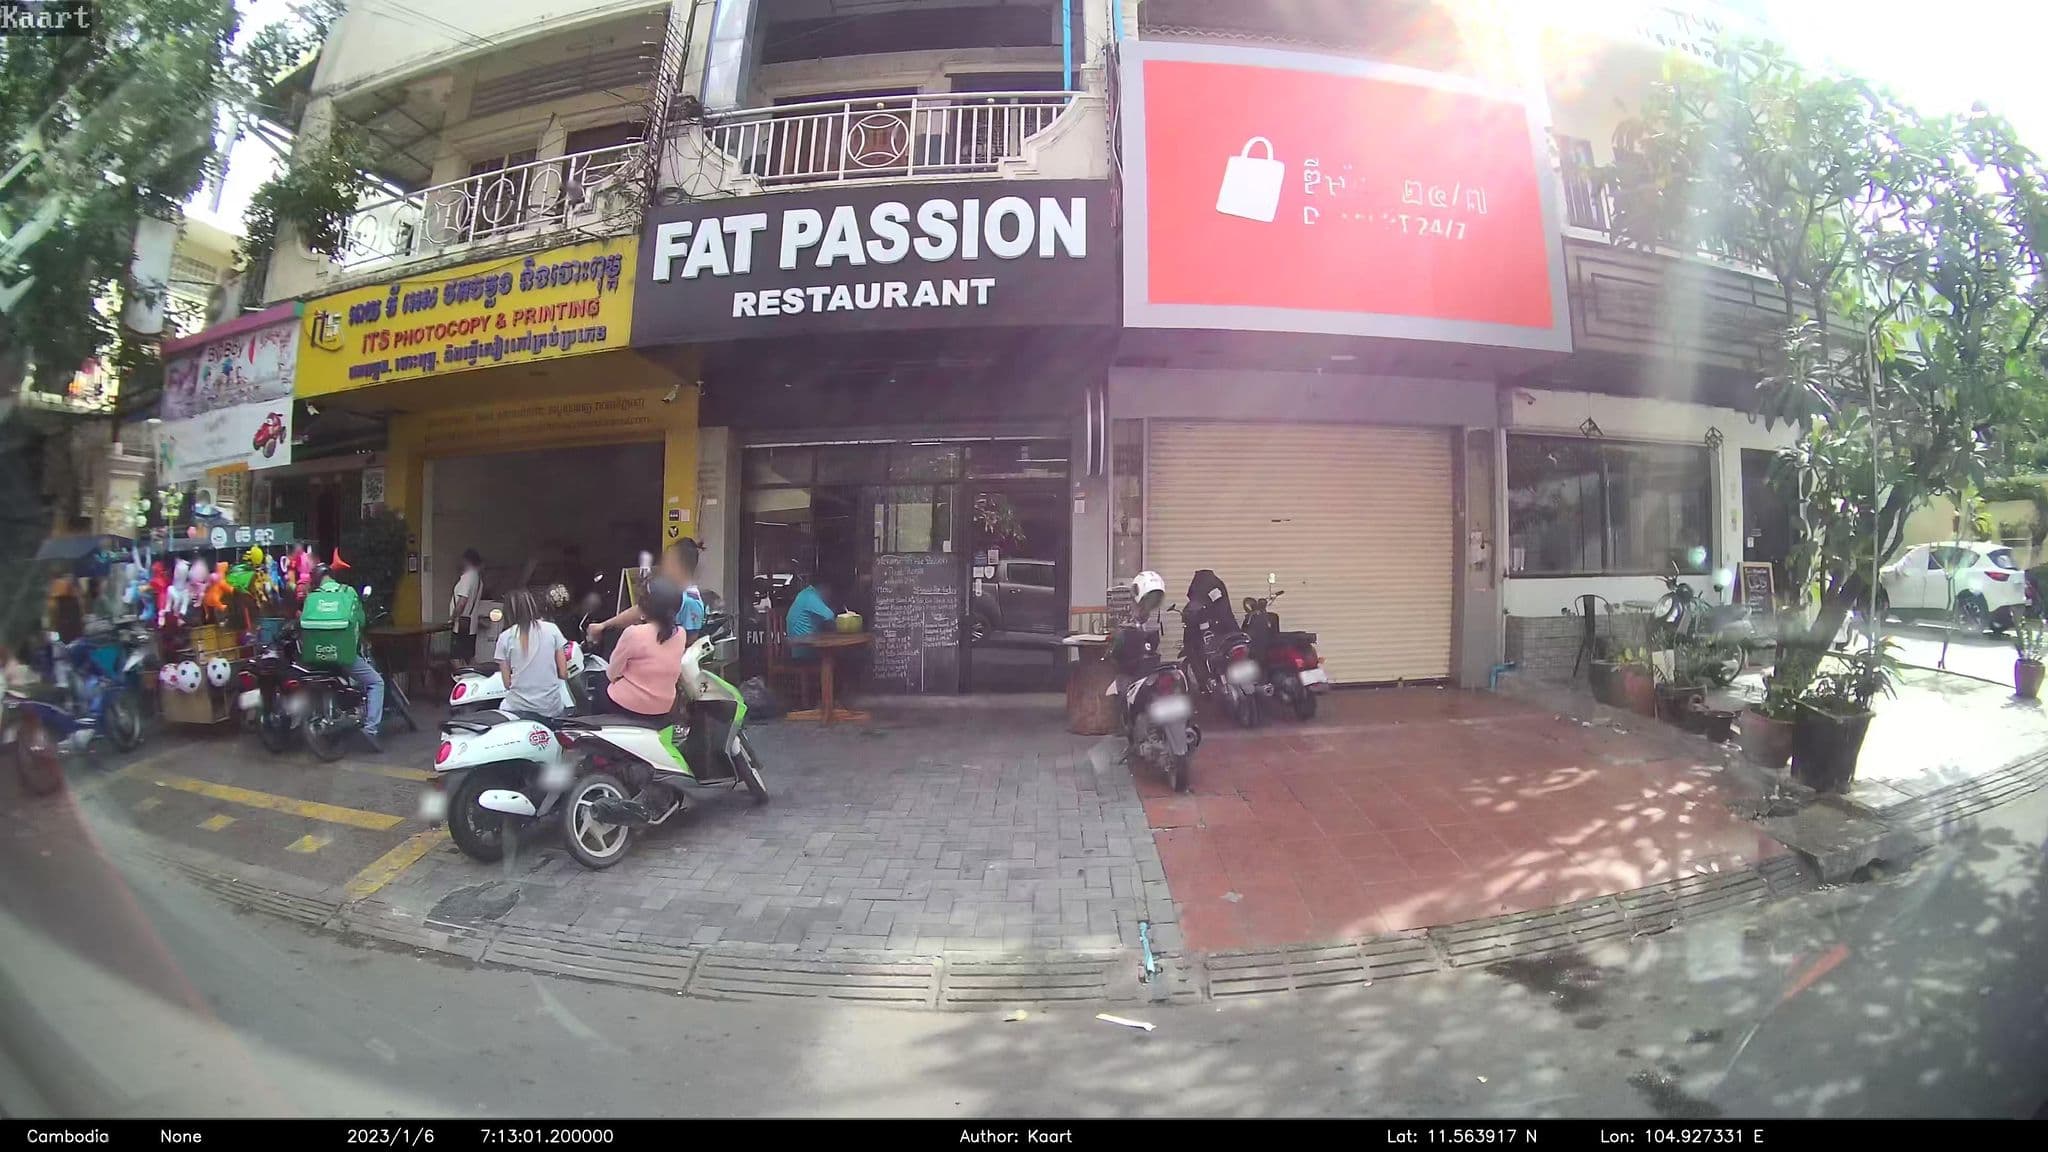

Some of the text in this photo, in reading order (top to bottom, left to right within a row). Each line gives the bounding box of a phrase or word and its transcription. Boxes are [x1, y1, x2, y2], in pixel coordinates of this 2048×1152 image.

[653, 197, 1086, 281] FAT PASSION
[733, 278, 996, 317] RESTAURANT
[394, 315, 490, 348] PHOTOCOPY
[494, 313, 507, 329] &
[512, 298, 600, 327] PRINTING
[746, 630, 765, 645] FAT
